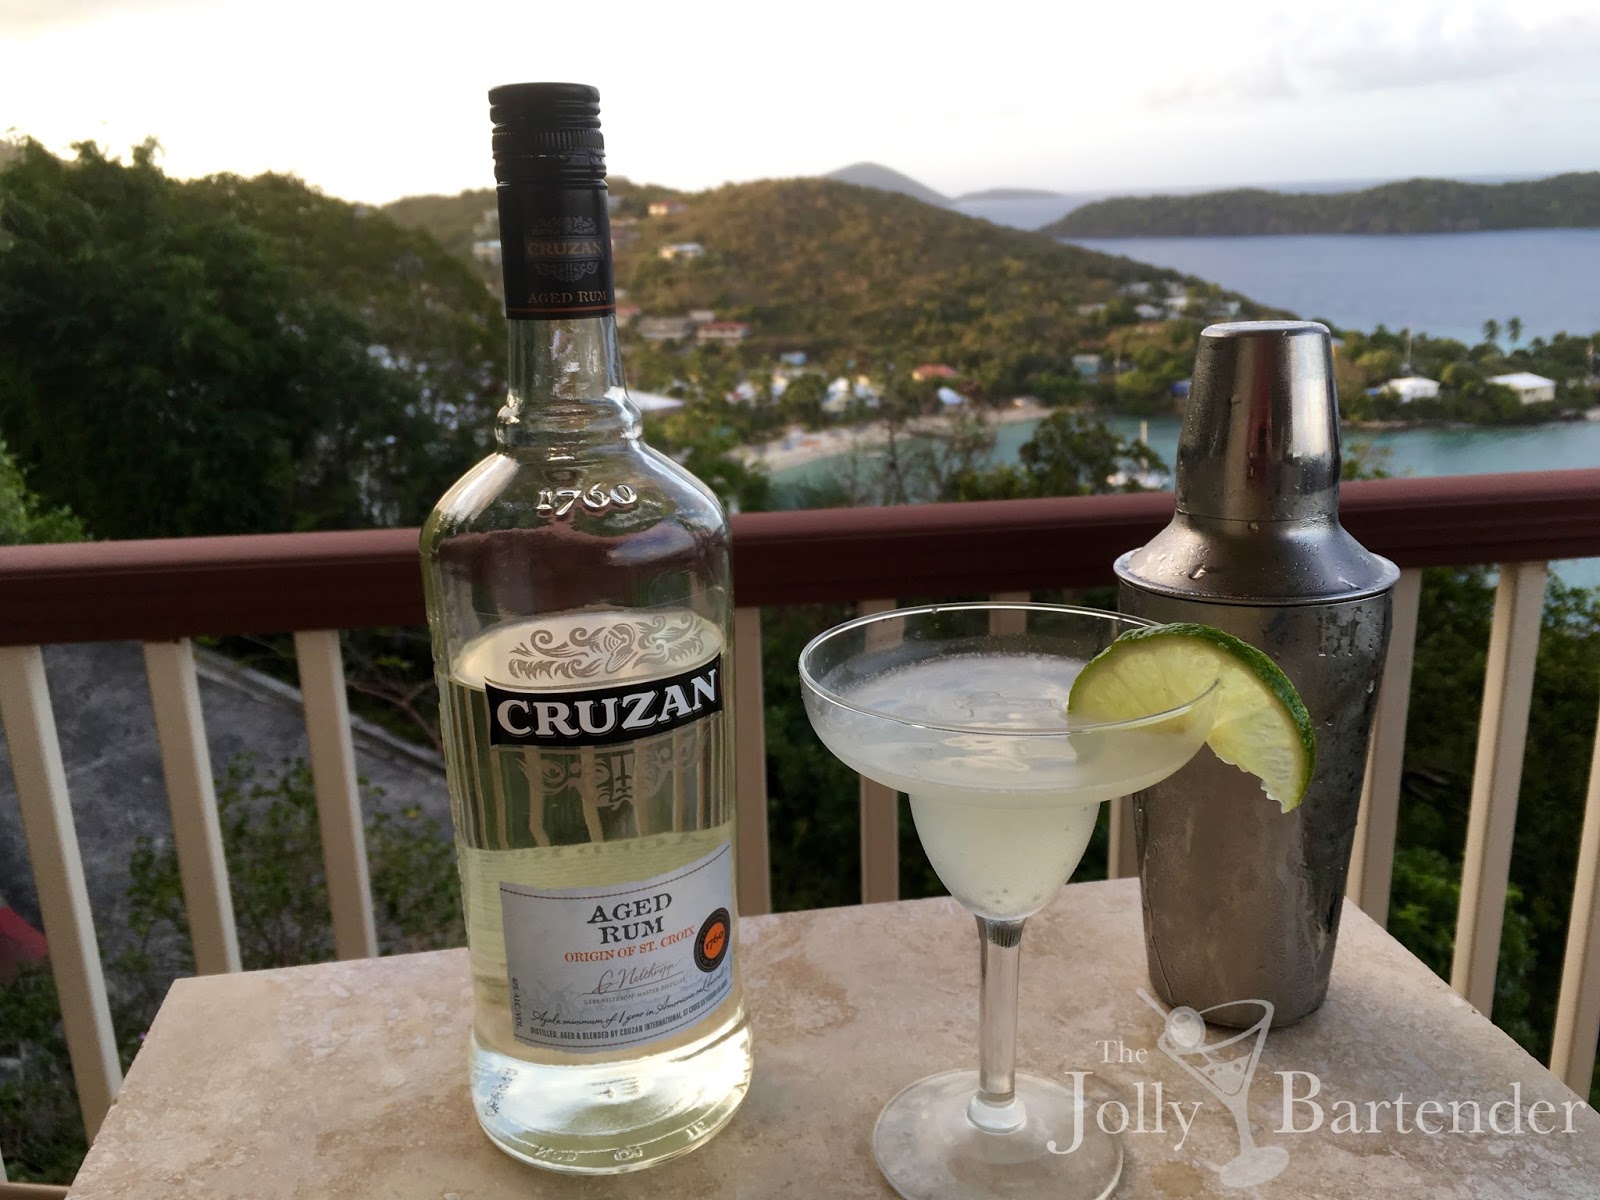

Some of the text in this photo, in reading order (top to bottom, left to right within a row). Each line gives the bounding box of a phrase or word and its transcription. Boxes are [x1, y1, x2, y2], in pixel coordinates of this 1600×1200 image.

[527, 240, 603, 257] CRUZAN
[528, 290, 606, 304] AGED RUM
[536, 482, 637, 516] 1760
[496, 668, 718, 738] CRUZAN
[587, 892, 672, 924] AGED
[564, 925, 696, 963] ORIGIN OF ST. CROIX
[598, 915, 665, 945] RUM
[705, 930, 724, 951] 1760
[531, 1010, 559, 1027] Aged
[602, 1013, 618, 1028] of
[622, 1012, 645, 1027] year
[646, 1009, 655, 1017] in
[655, 995, 695, 1015] American
[560, 1031, 575, 1040] AGED
[576, 1032, 581, 1040] &
[582, 1030, 609, 1040] BLENDED
[610, 1029, 619, 1038] BY
[619, 1024, 644, 1037] CRUZAN
